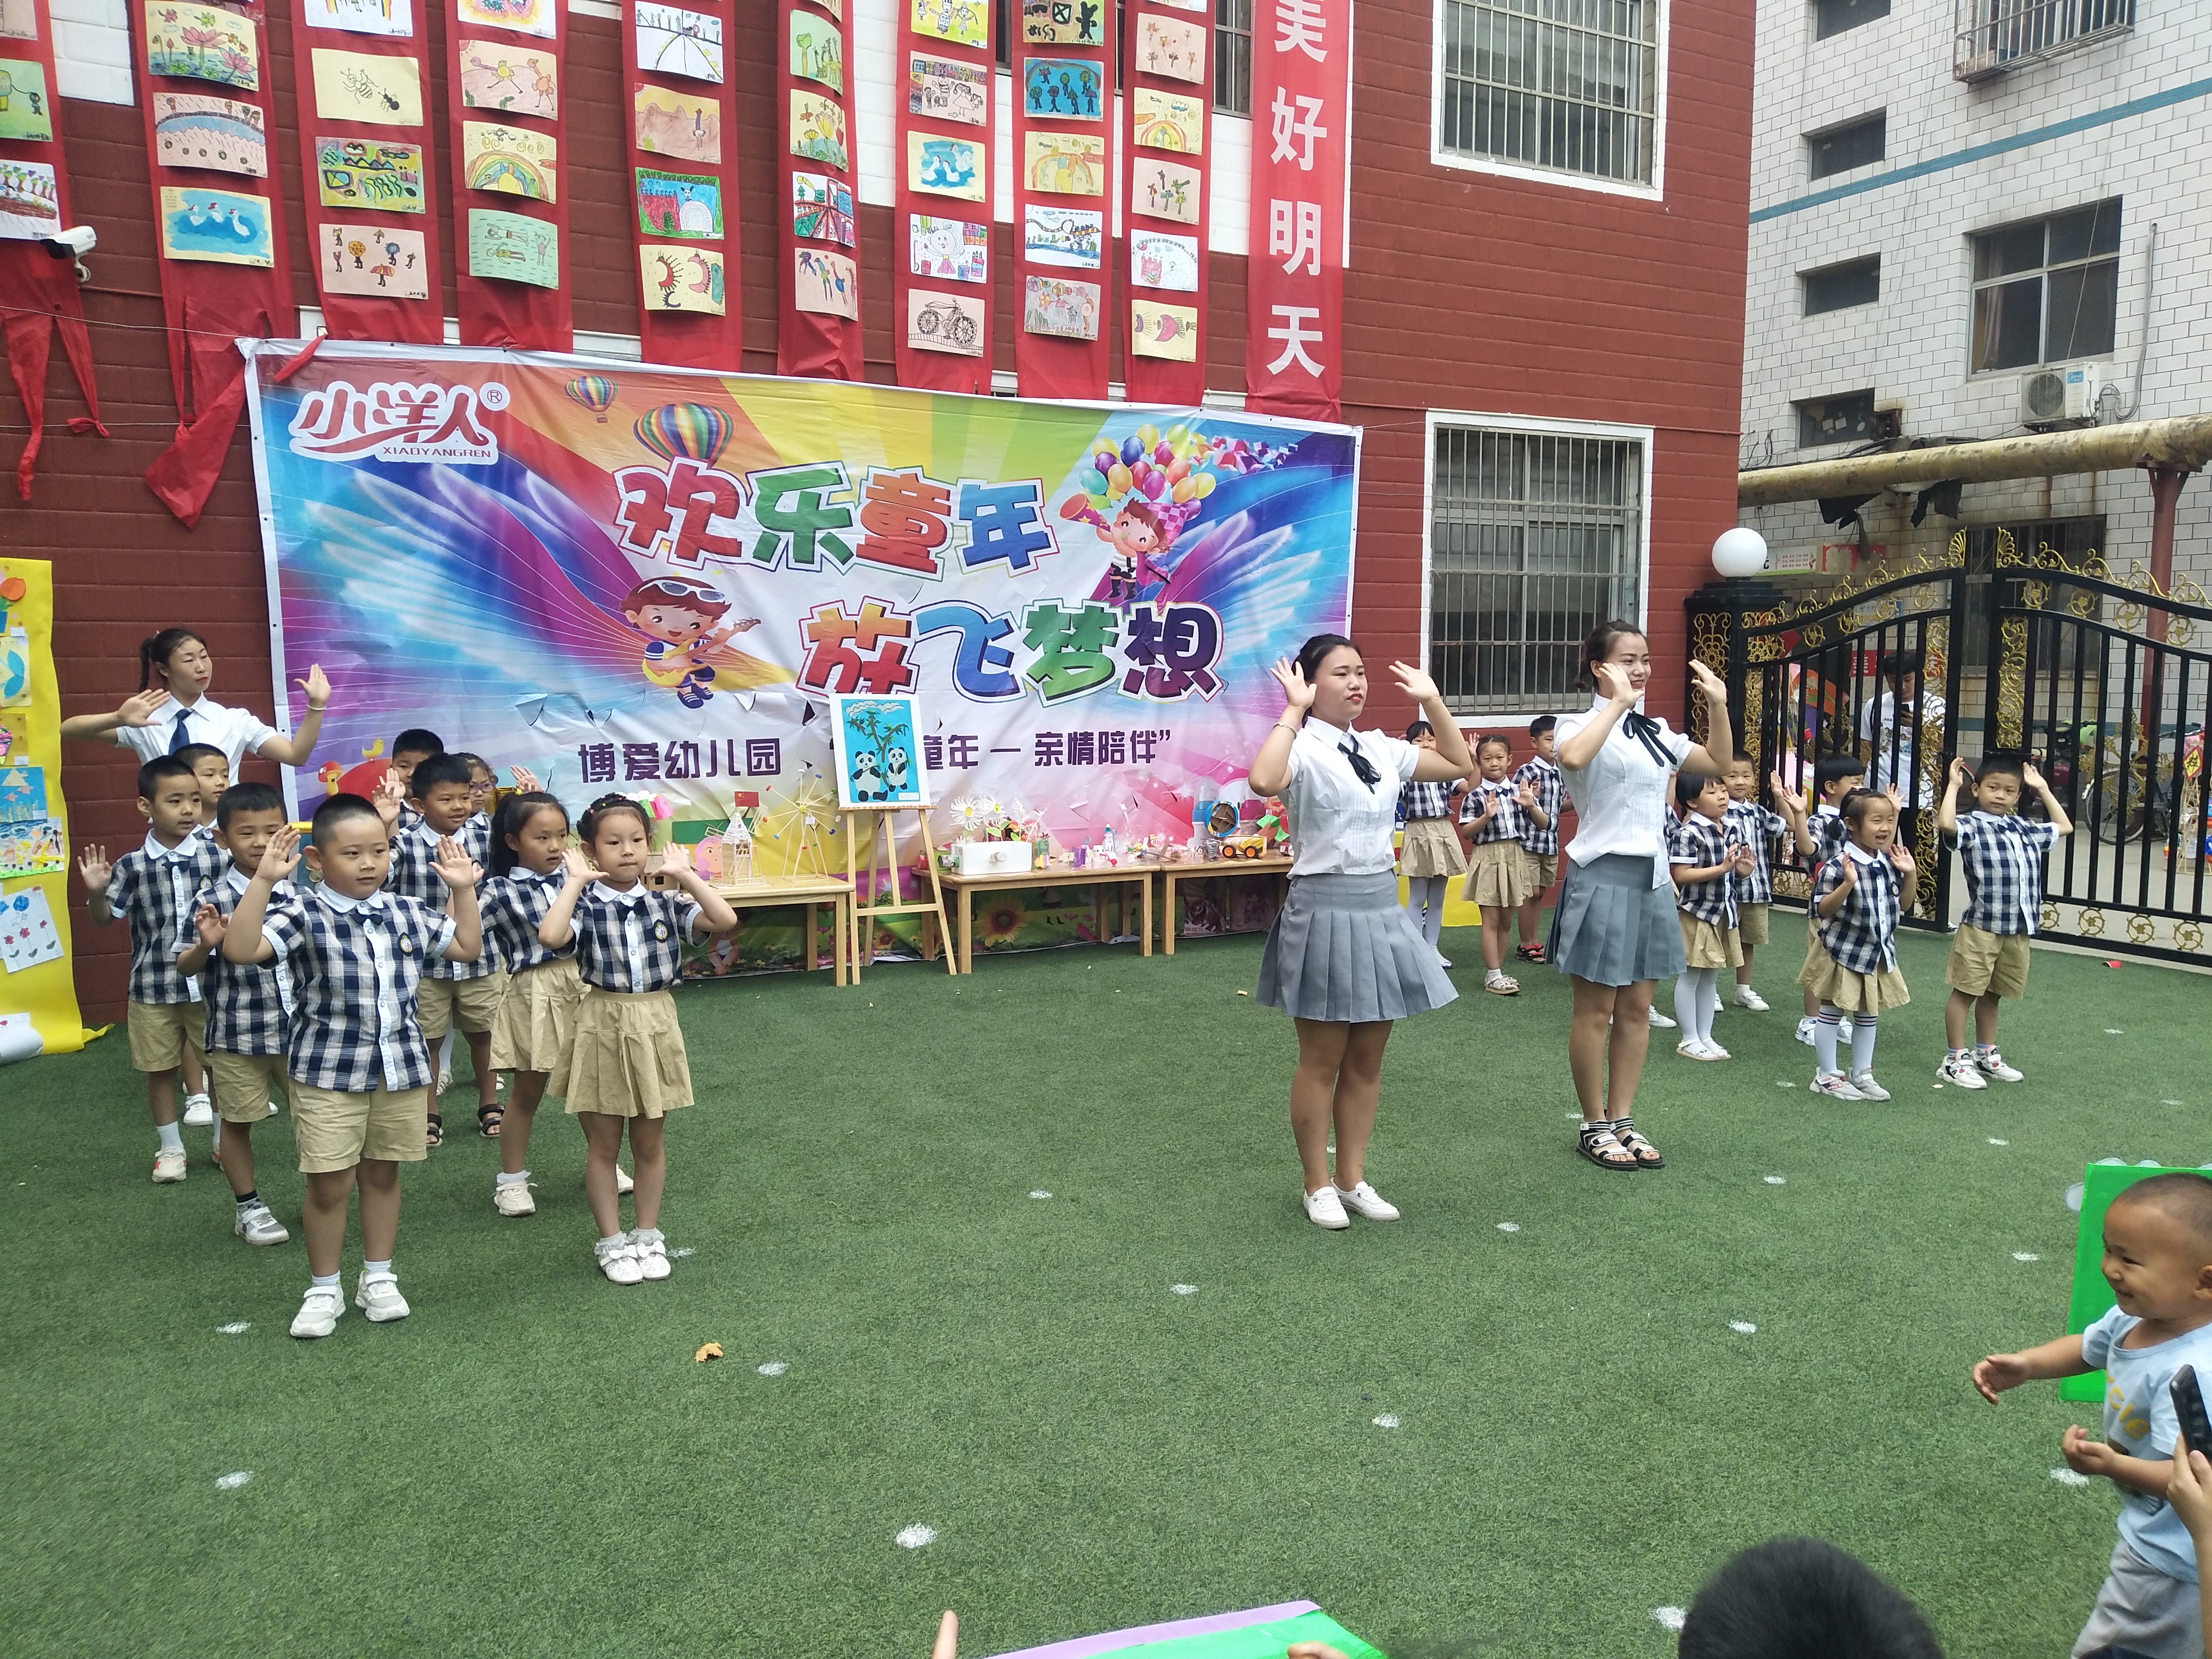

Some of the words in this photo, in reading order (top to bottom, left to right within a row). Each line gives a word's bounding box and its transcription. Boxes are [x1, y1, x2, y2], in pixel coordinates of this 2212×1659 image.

[298, 388, 490, 454] 小洋人
[383, 446, 491, 458] XIAOYANGREN
[615, 456, 1055, 577] 欢乐童年
[798, 601, 1225, 705] 放飞梦想
[577, 737, 781, 783] 博爱幼儿园
